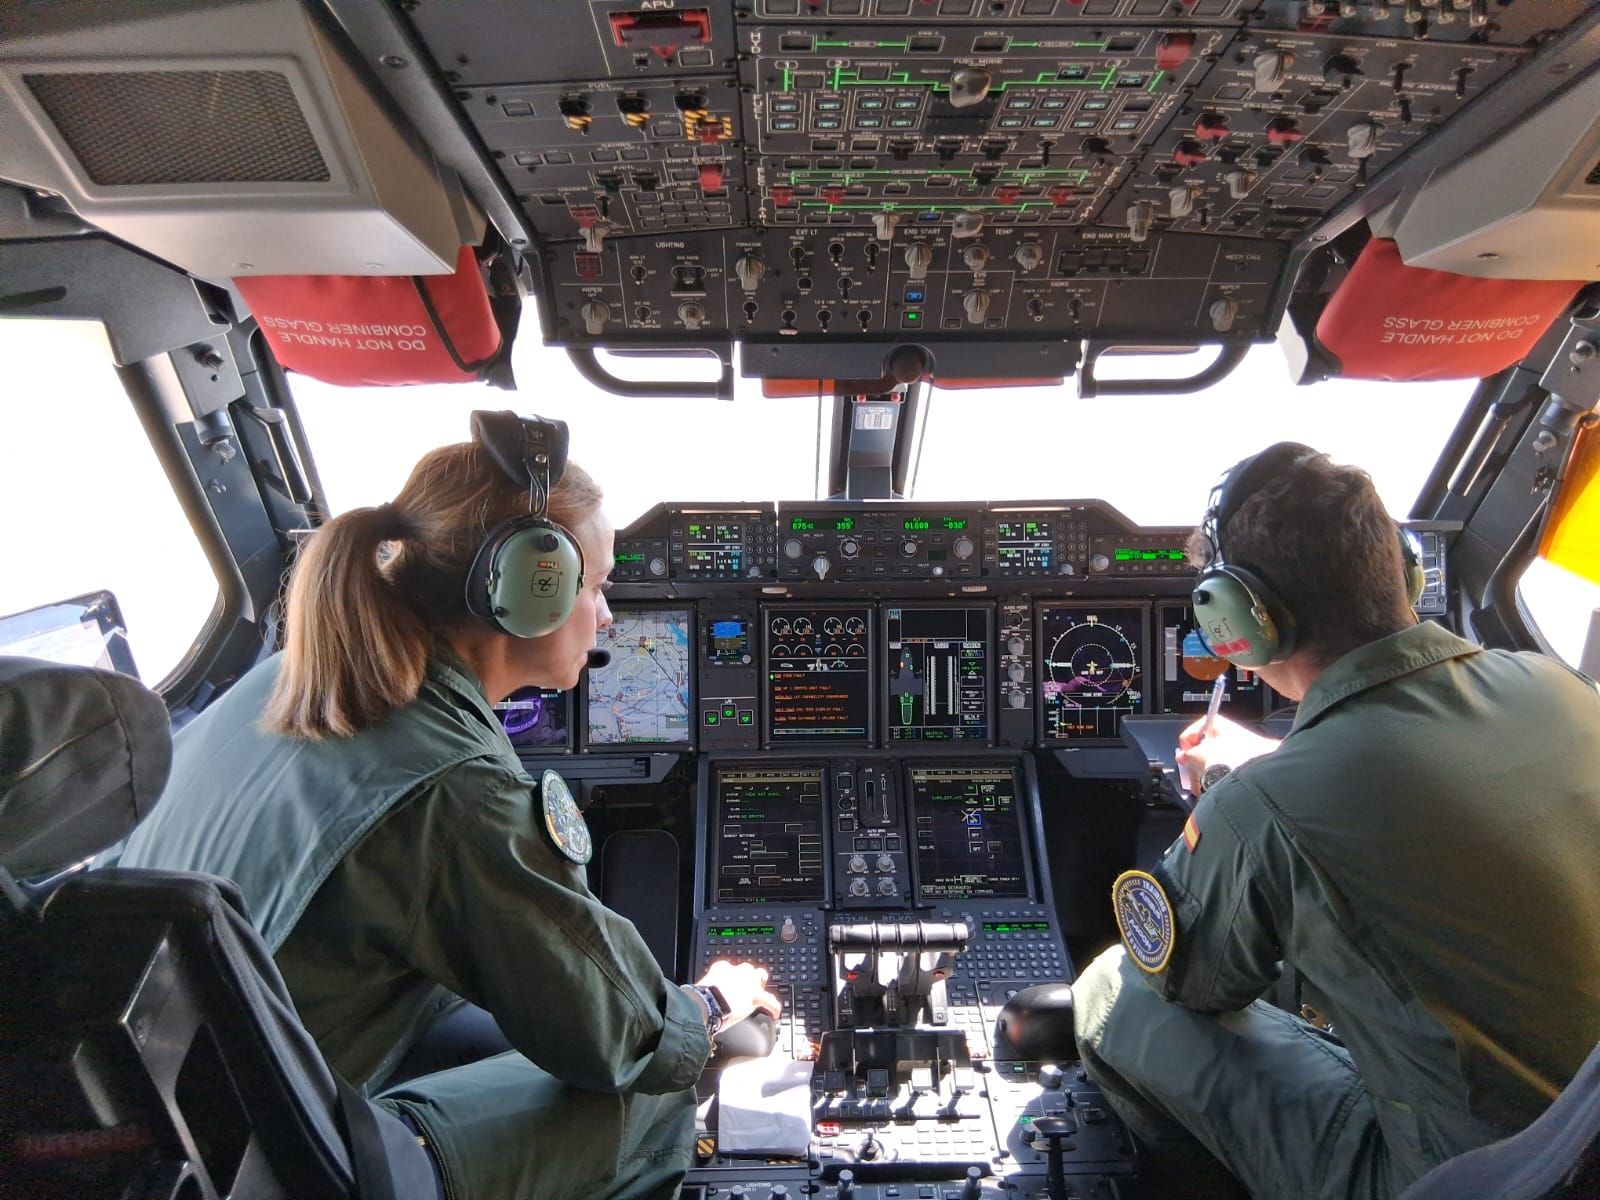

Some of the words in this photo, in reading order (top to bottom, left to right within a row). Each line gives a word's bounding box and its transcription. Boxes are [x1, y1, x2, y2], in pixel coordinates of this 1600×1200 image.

[641, 0, 674, 9] APU
[750, 32, 761, 54] HYD
[1200, 34, 1223, 56] HYD
[264, 316, 323, 332] GLASS
[1384, 316, 1444, 330] GLASS
[1448, 314, 1540, 330] COMBINER
[326, 323, 427, 336] COMBINER
[1456, 330, 1494, 342] NOT
[1496, 328, 1524, 340] DO
[278, 332, 350, 348] HANDLE
[357, 338, 394, 350] NOT
[1381, 332, 1455, 344] HANDLE
[398, 340, 426, 351] DO
[1142, 880, 1167, 912] TRAINING
